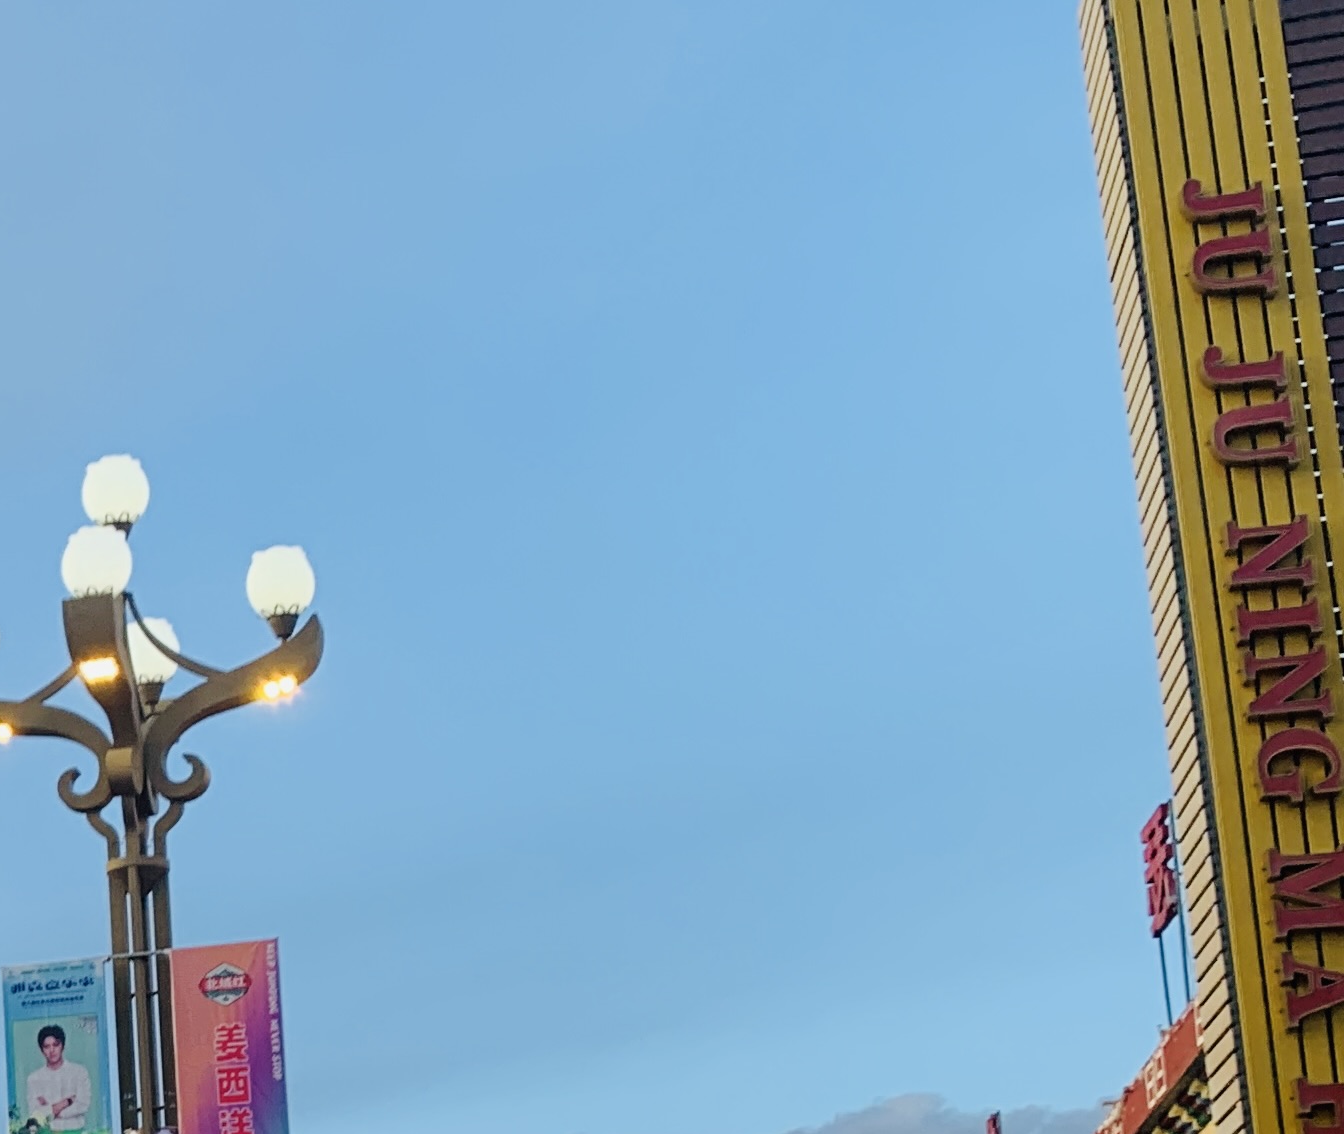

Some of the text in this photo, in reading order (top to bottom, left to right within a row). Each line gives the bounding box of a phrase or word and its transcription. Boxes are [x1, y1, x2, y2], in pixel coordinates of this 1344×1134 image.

[1181, 178, 1278, 297] JU
[1200, 345, 1299, 469] JU
[1226, 515, 1343, 802] NING
[1268, 846, 1344, 1034] MA
